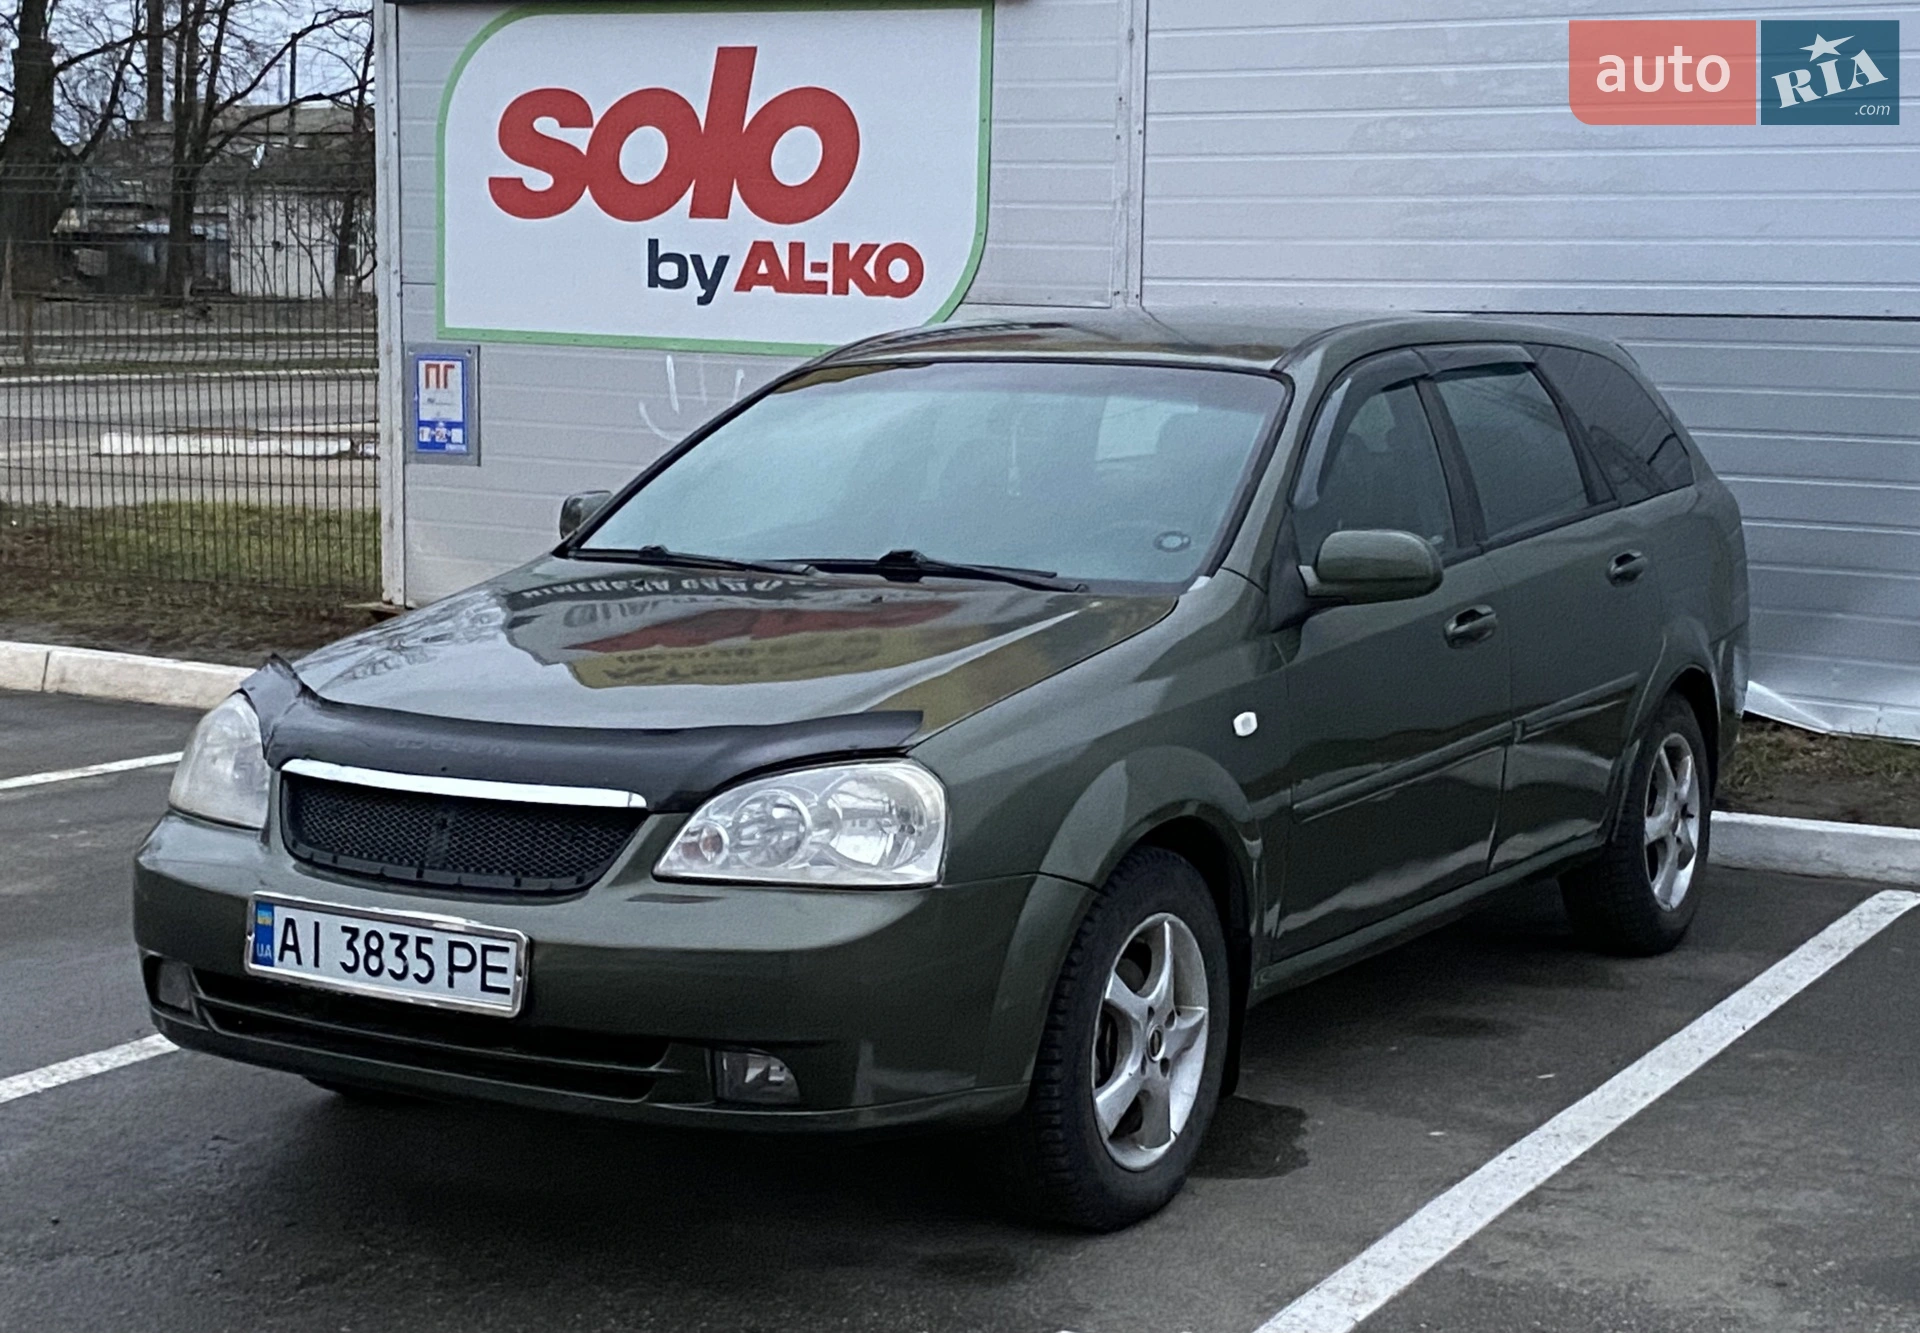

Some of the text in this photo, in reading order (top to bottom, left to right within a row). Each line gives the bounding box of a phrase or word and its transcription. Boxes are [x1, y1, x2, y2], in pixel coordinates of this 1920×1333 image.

[487, 46, 861, 225] solo
[647, 238, 925, 306] by AL-KO
[425, 363, 455, 389] ПГ
[256, 943, 272, 959] UA
[278, 917, 511, 996] AI 3835 PE
